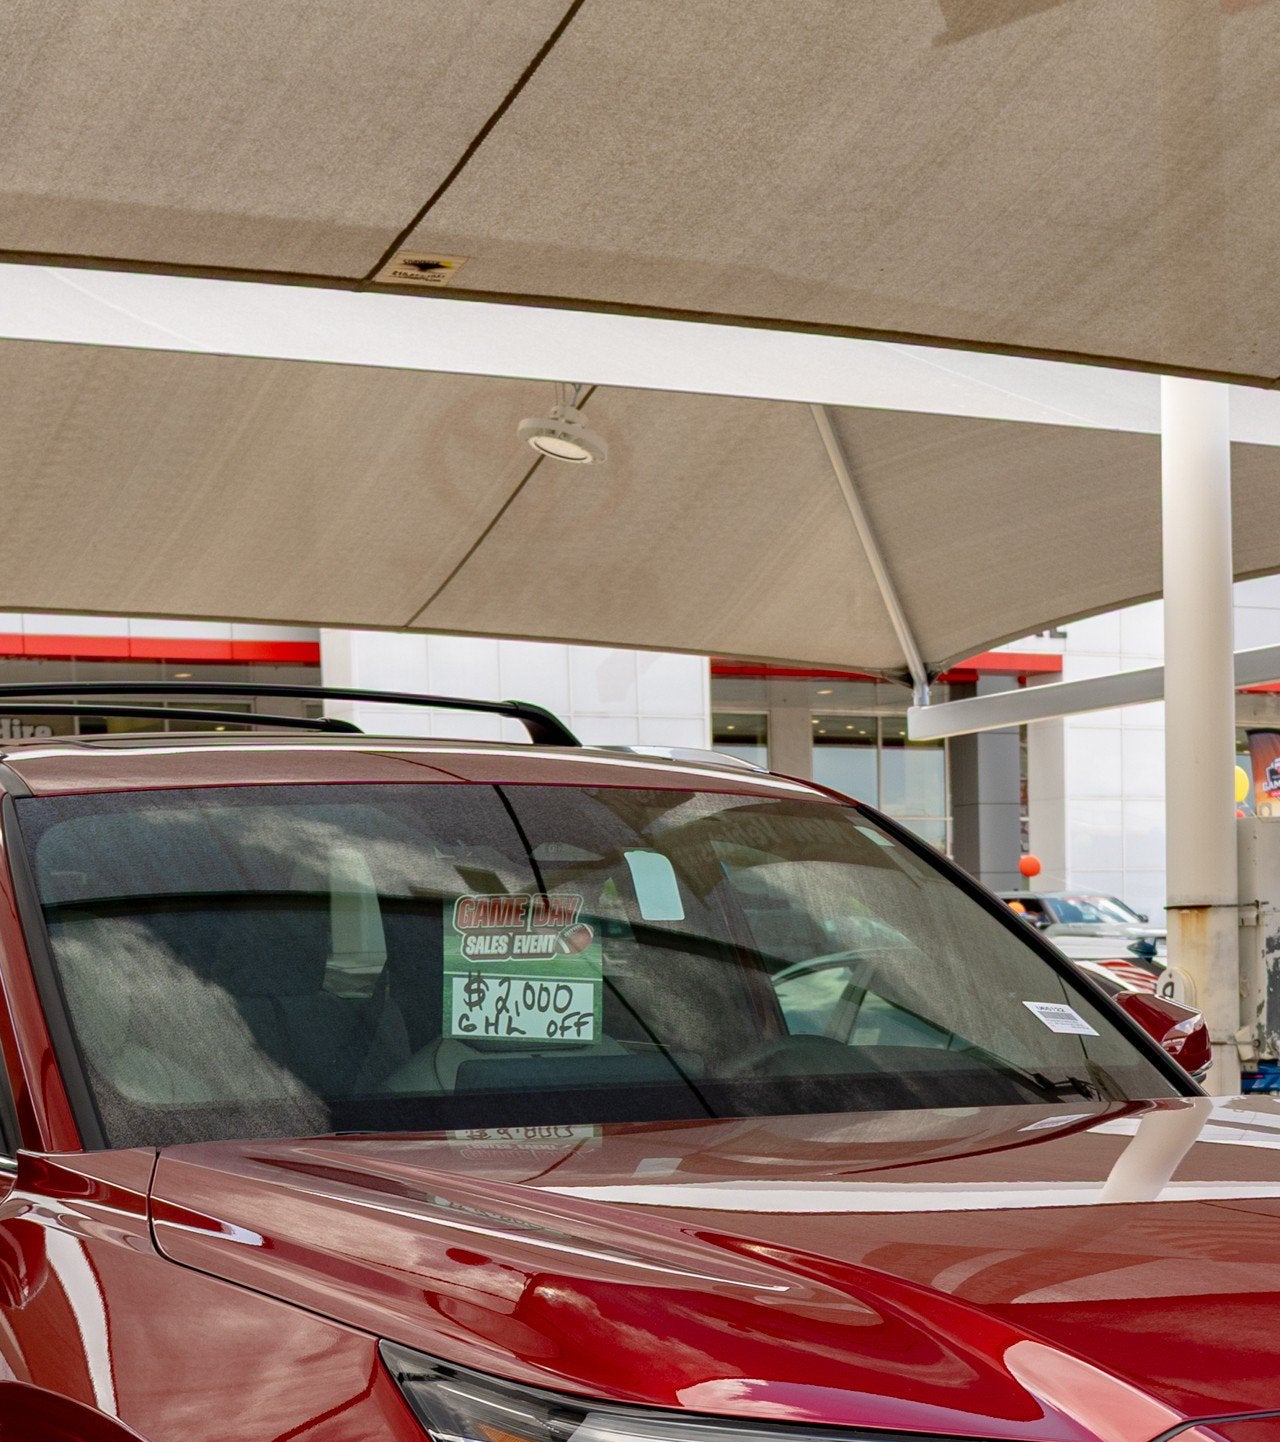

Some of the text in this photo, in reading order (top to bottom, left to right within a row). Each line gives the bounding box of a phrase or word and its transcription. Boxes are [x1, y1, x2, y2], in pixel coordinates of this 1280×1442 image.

[457, 898, 579, 929] GAME DAY
[465, 934, 557, 955] SALES EVENT
[546, 1011, 594, 1038] OFF
